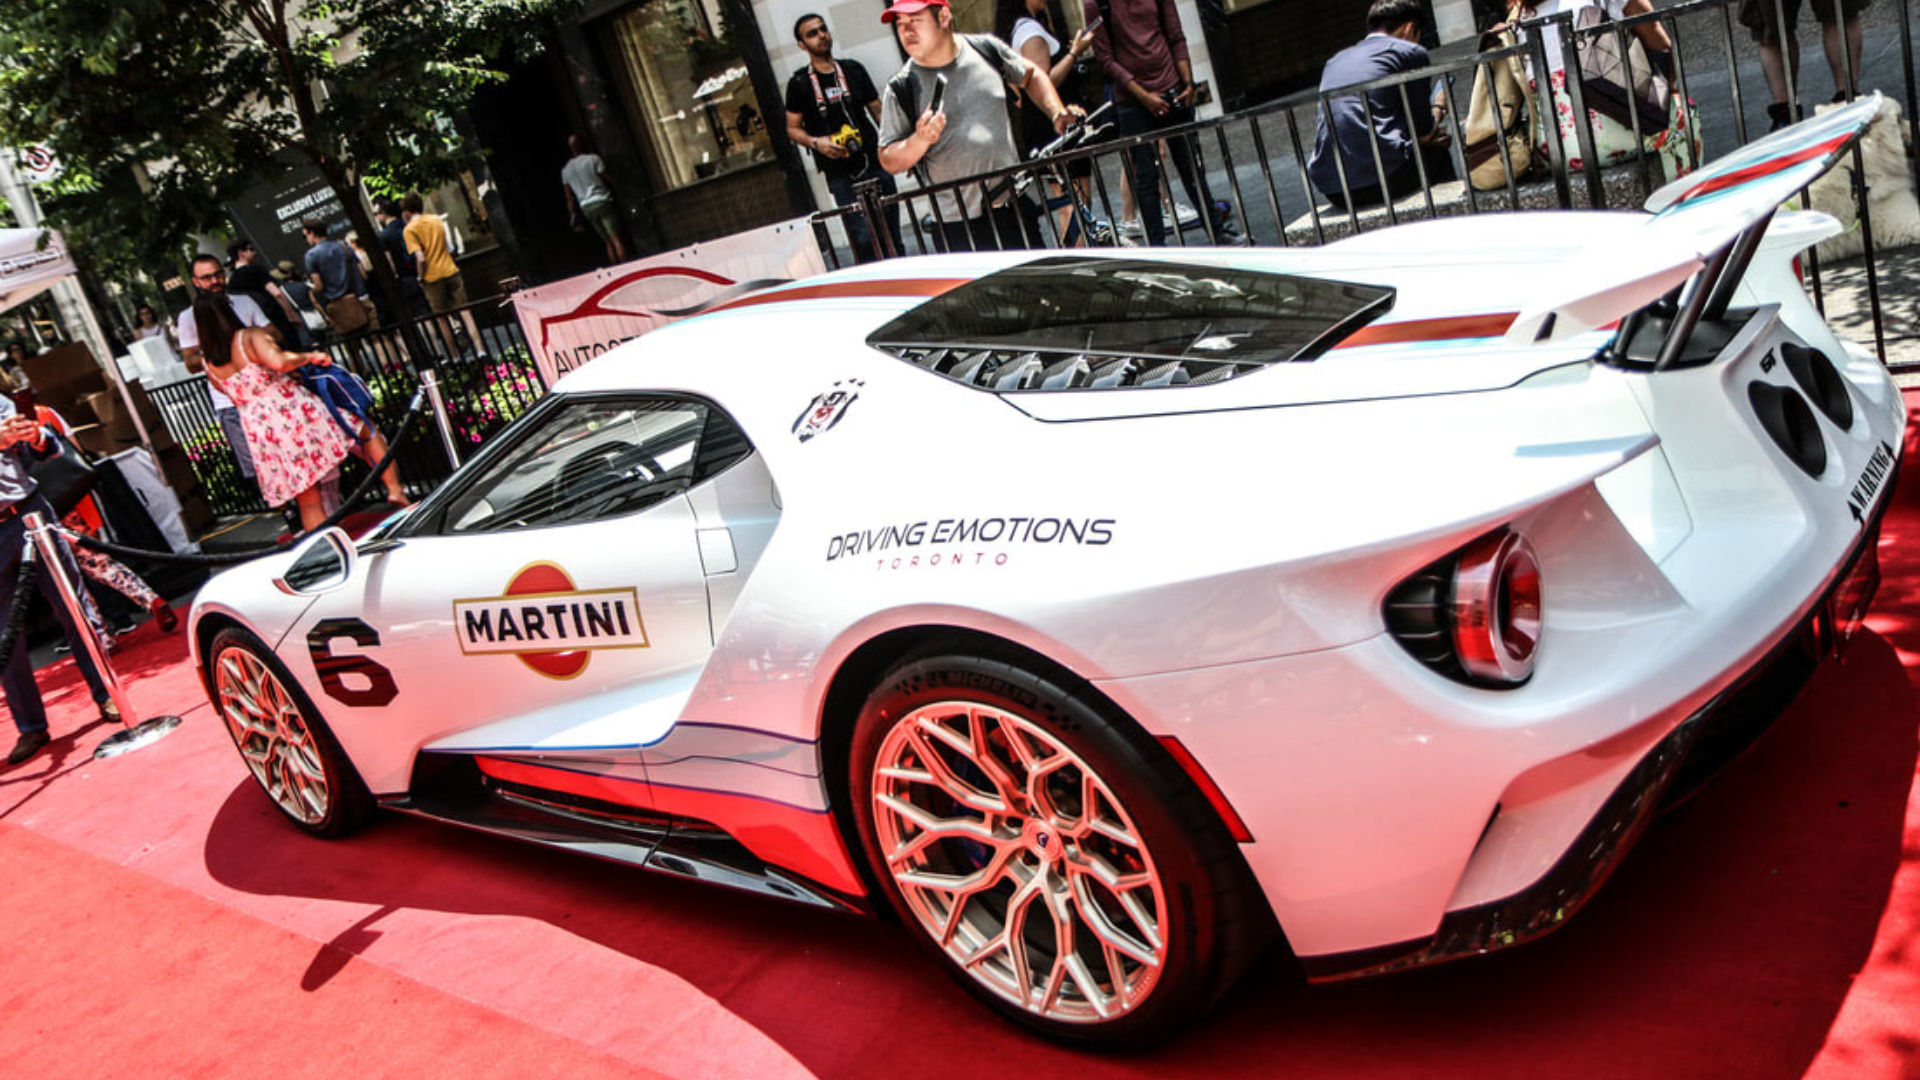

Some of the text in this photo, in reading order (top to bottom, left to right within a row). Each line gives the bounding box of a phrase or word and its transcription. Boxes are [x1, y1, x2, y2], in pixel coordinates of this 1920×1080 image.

[1851, 445, 1889, 510] WARNING
[826, 517, 1116, 561] DRIVING EMOTIONS
[877, 552, 1008, 570] TORONTO
[464, 600, 631, 643] MARTINI
[305, 617, 400, 707] 6
